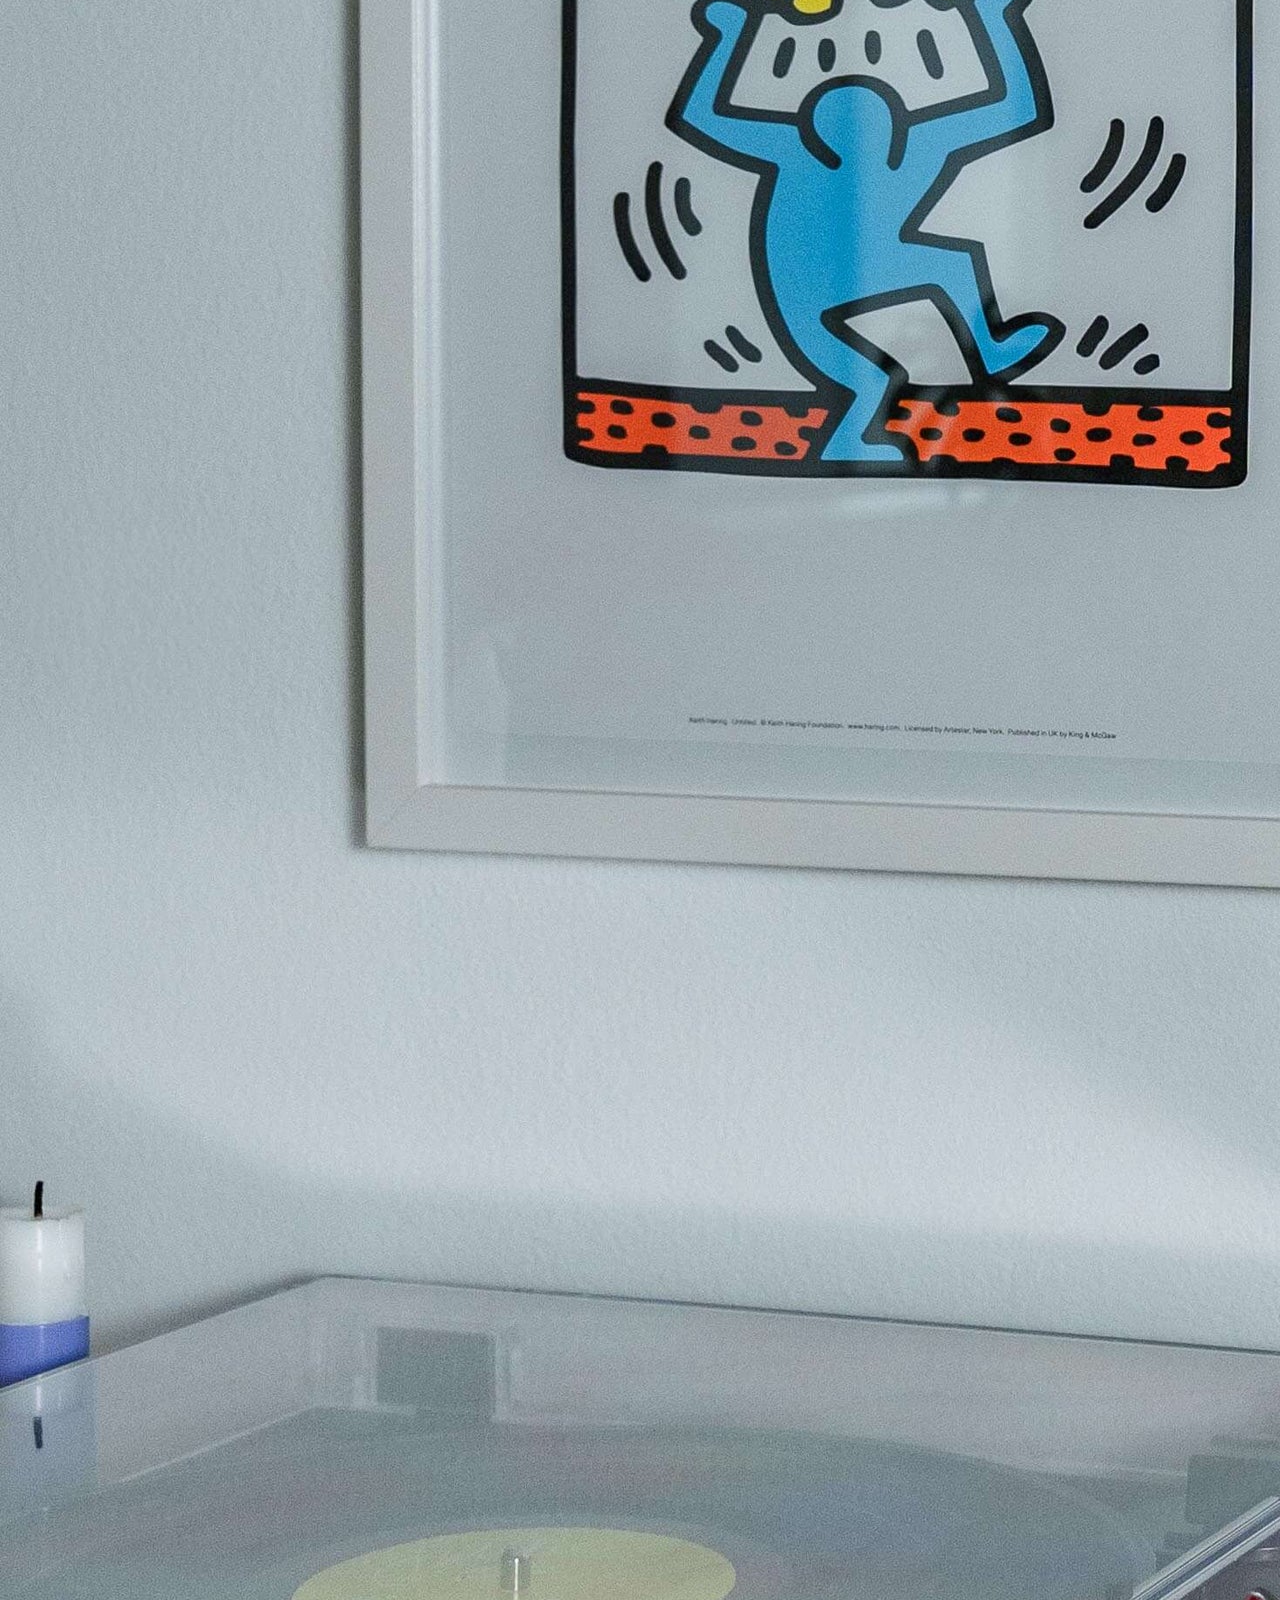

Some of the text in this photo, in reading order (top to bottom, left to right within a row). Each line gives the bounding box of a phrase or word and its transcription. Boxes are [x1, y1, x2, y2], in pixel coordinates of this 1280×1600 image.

[934, 726, 942, 735] by
[973, 727, 988, 735] New
[1007, 728, 1040, 737] Published
[1068, 731, 1084, 740] King
